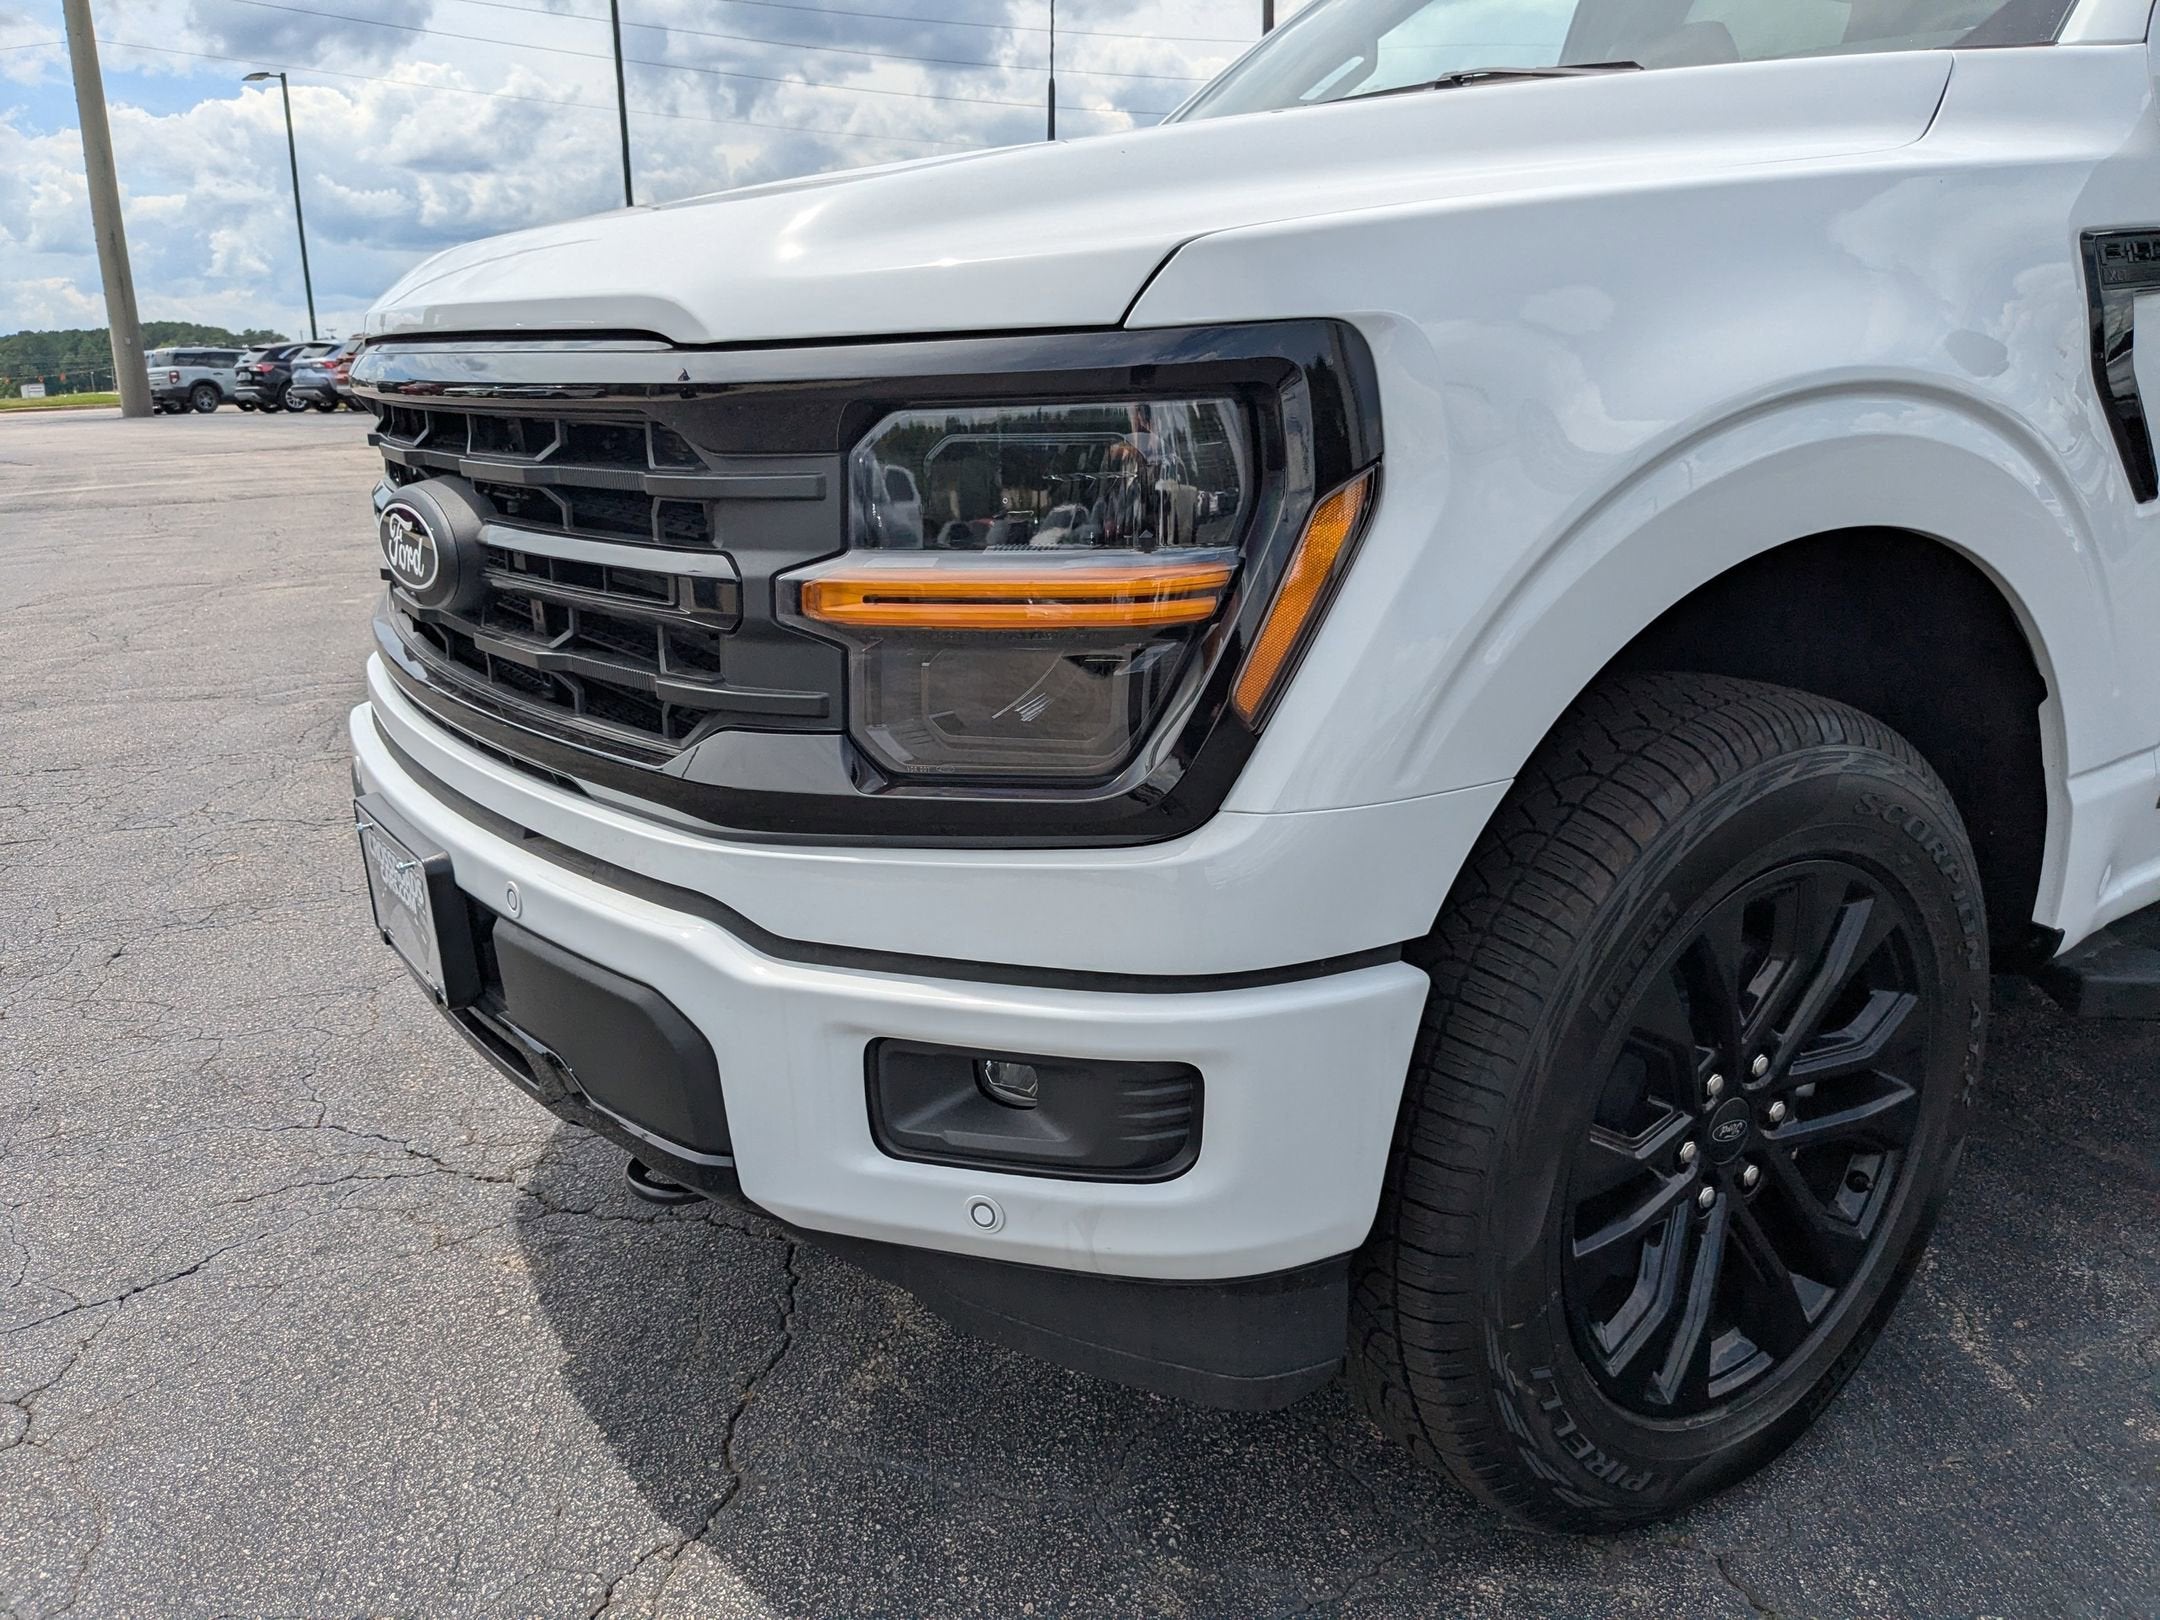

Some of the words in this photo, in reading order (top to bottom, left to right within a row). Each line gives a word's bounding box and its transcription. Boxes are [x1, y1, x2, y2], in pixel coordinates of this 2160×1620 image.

[388, 513, 425, 577] Ford
[1854, 792, 1982, 970] SCORPION
[1718, 1122, 1743, 1139] Ford
[1530, 1366, 1654, 1491] PIRELLI
